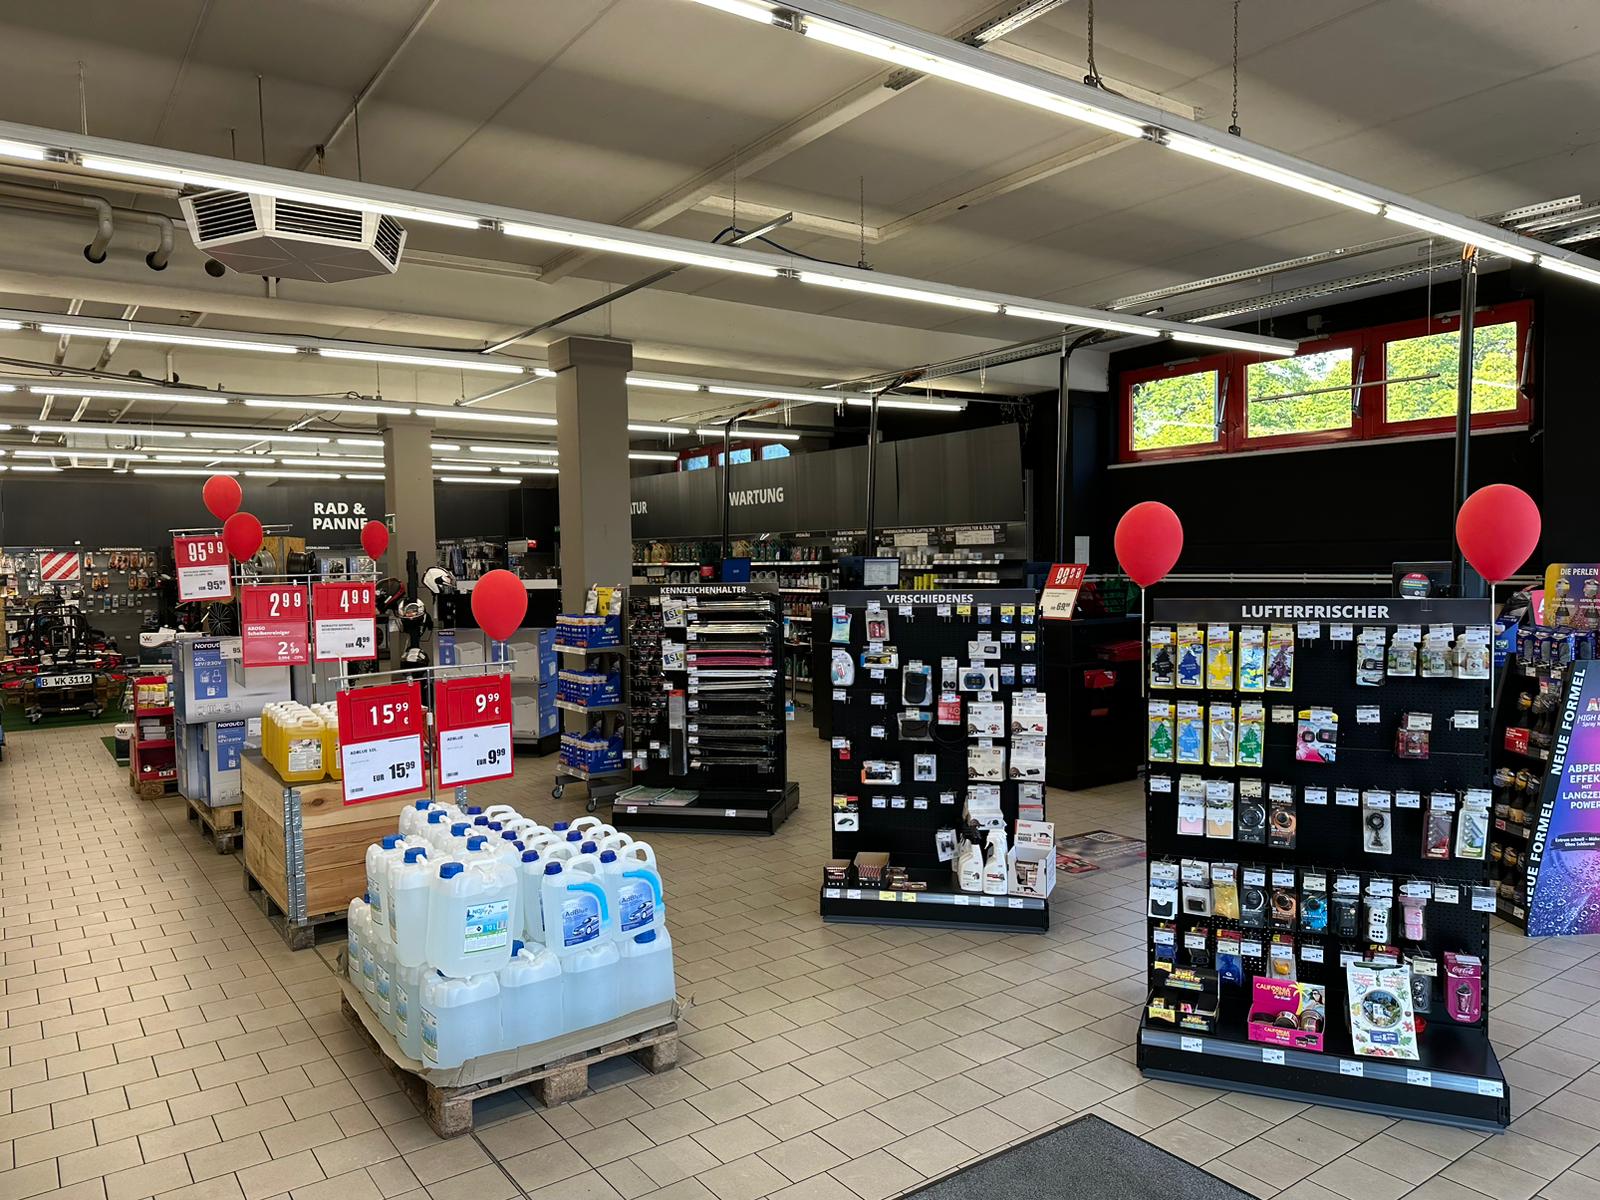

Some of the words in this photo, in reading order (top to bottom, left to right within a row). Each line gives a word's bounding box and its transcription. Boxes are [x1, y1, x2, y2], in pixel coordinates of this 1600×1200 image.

[729, 487, 784, 506] WARTUNG
[313, 502, 349, 515] RAD
[353, 502, 366, 515] &
[188, 542, 207, 562] 95
[1560, 568, 1571, 576] DIE
[1572, 568, 1599, 576] PERLEN
[660, 586, 747, 595] KENNZEICHENHALTER
[886, 593, 974, 604] VERSCHIEDENES
[269, 592, 280, 617] 2
[340, 590, 349, 613] 4
[1241, 604, 1390, 619] LUFTERFRISCHER
[278, 641, 288, 655] 2
[42, 678, 49, 686] B
[54, 677, 66, 685] WK
[68, 675, 91, 685] 3112
[475, 693, 486, 713] 9
[487, 692, 500, 702] 99
[369, 703, 394, 726] 15
[395, 702, 409, 712] 99
[1551, 734, 1570, 776] NEUE
[1562, 668, 1586, 731] FORMEL
[1577, 714, 1596, 724] HIGH
[372, 773, 385, 782] EUR
[388, 761, 416, 780] 15,99
[1530, 801, 1554, 862] FORMEL
[565, 908, 589, 917] AdBlue
